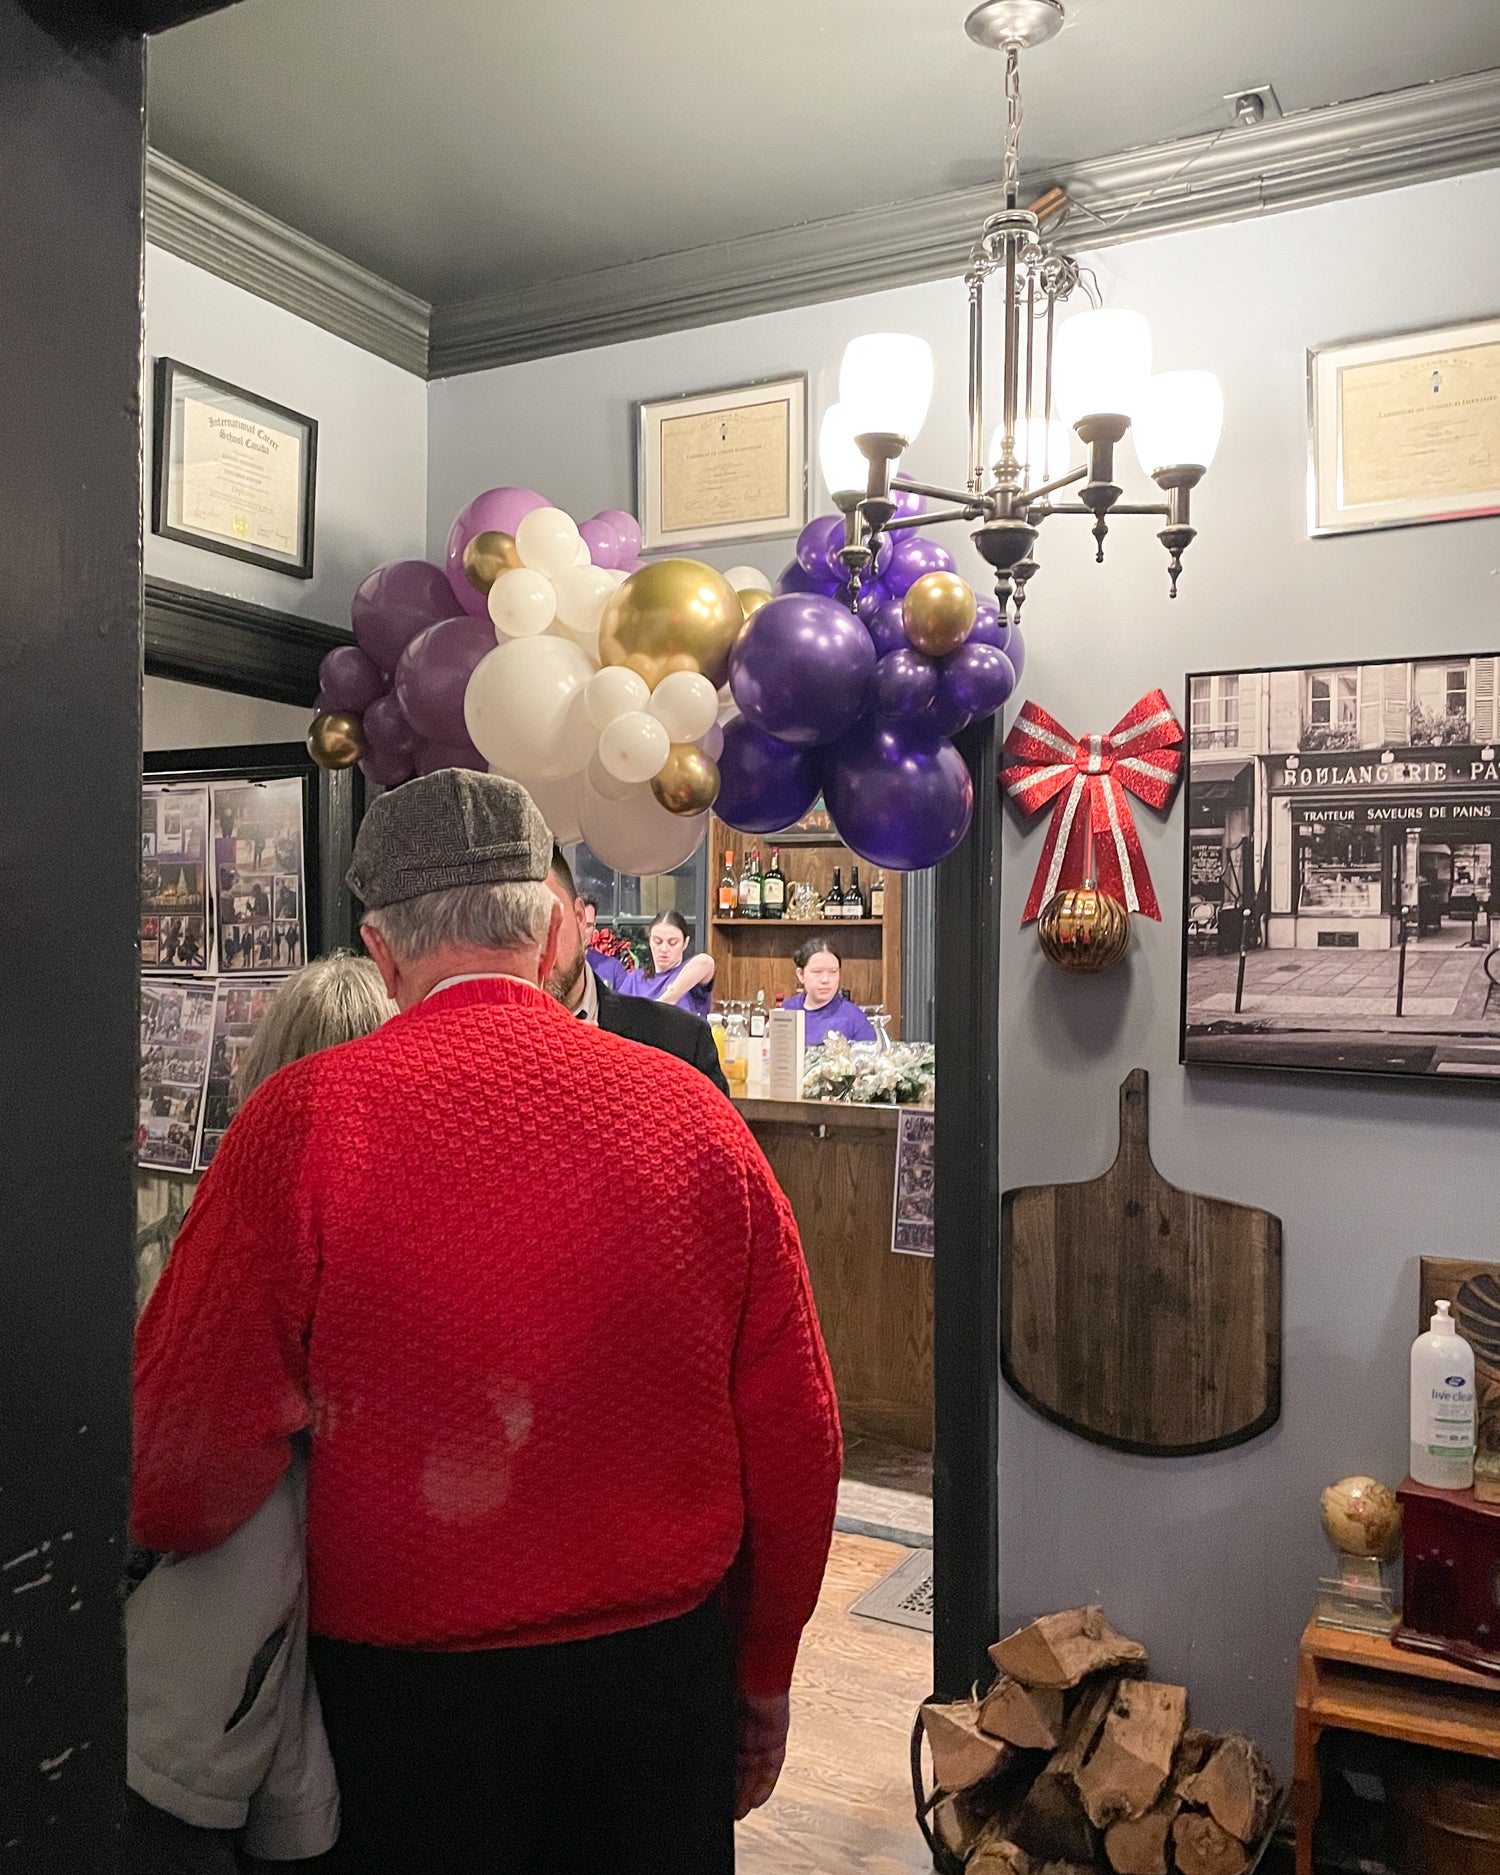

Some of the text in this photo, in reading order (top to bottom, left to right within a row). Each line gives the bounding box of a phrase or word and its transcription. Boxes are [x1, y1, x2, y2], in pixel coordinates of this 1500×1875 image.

[208, 416, 280, 450] International Career
[219, 429, 270, 454] School Canada
[1283, 761, 1500, 786] BOULANGERIE PA
[1303, 805, 1492, 821] TRAITEUR SAVEURS DE PAINS
[1432, 1388, 1450, 1400] live
